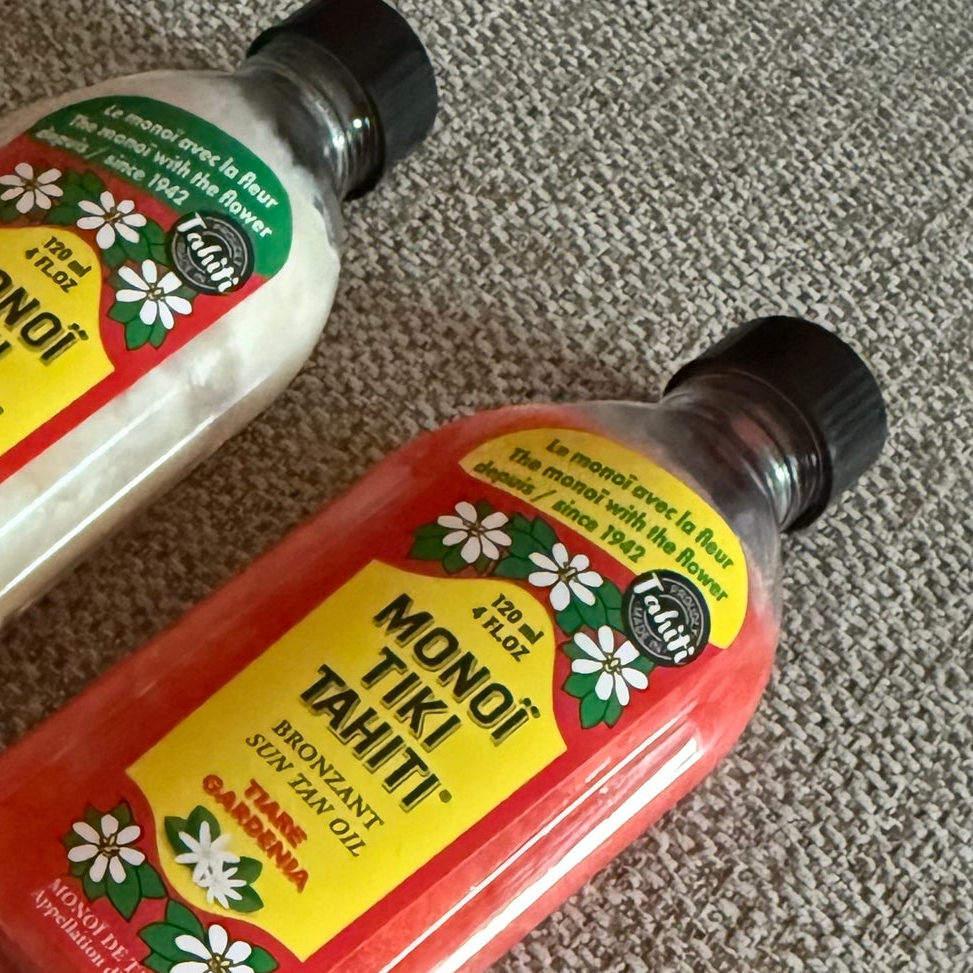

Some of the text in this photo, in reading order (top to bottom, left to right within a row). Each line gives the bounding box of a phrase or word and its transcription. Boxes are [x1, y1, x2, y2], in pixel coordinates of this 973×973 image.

[68, 113, 98, 134] The
[154, 147, 191, 178] with
[190, 170, 219, 198] the
[218, 190, 273, 239] flower
[103, 104, 124, 119] Le
[177, 137, 221, 167] avec
[218, 157, 239, 179] la
[237, 171, 279, 209] fleur
[103, 154, 146, 181] since
[148, 173, 190, 207] 1942
[42, 235, 74, 264] 120
[177, 211, 239, 293] Tahiti
[473, 459, 535, 496] depuis
[550, 495, 600, 533] since
[600, 523, 647, 564] 1942
[508, 447, 542, 472] The
[606, 497, 647, 533] with
[646, 525, 677, 556] the
[675, 547, 729, 602] flower
[545, 438, 735, 570] Le monoï avec la fleur
[471, 606, 486, 620] 4
[490, 593, 523, 623] 120
[633, 572, 695, 664] Tahiti
[360, 646, 463, 753] TIKI
[372, 593, 541, 747] MONOÏ
[244, 778, 307, 850] TIARE
[245, 733, 367, 858] SUN TAN OIL
[272, 719, 385, 830] BRONZANT
[202, 774, 309, 894] GARDENIA
[31, 889, 105, 968] Appellation
[100, 933, 128, 962] DE
